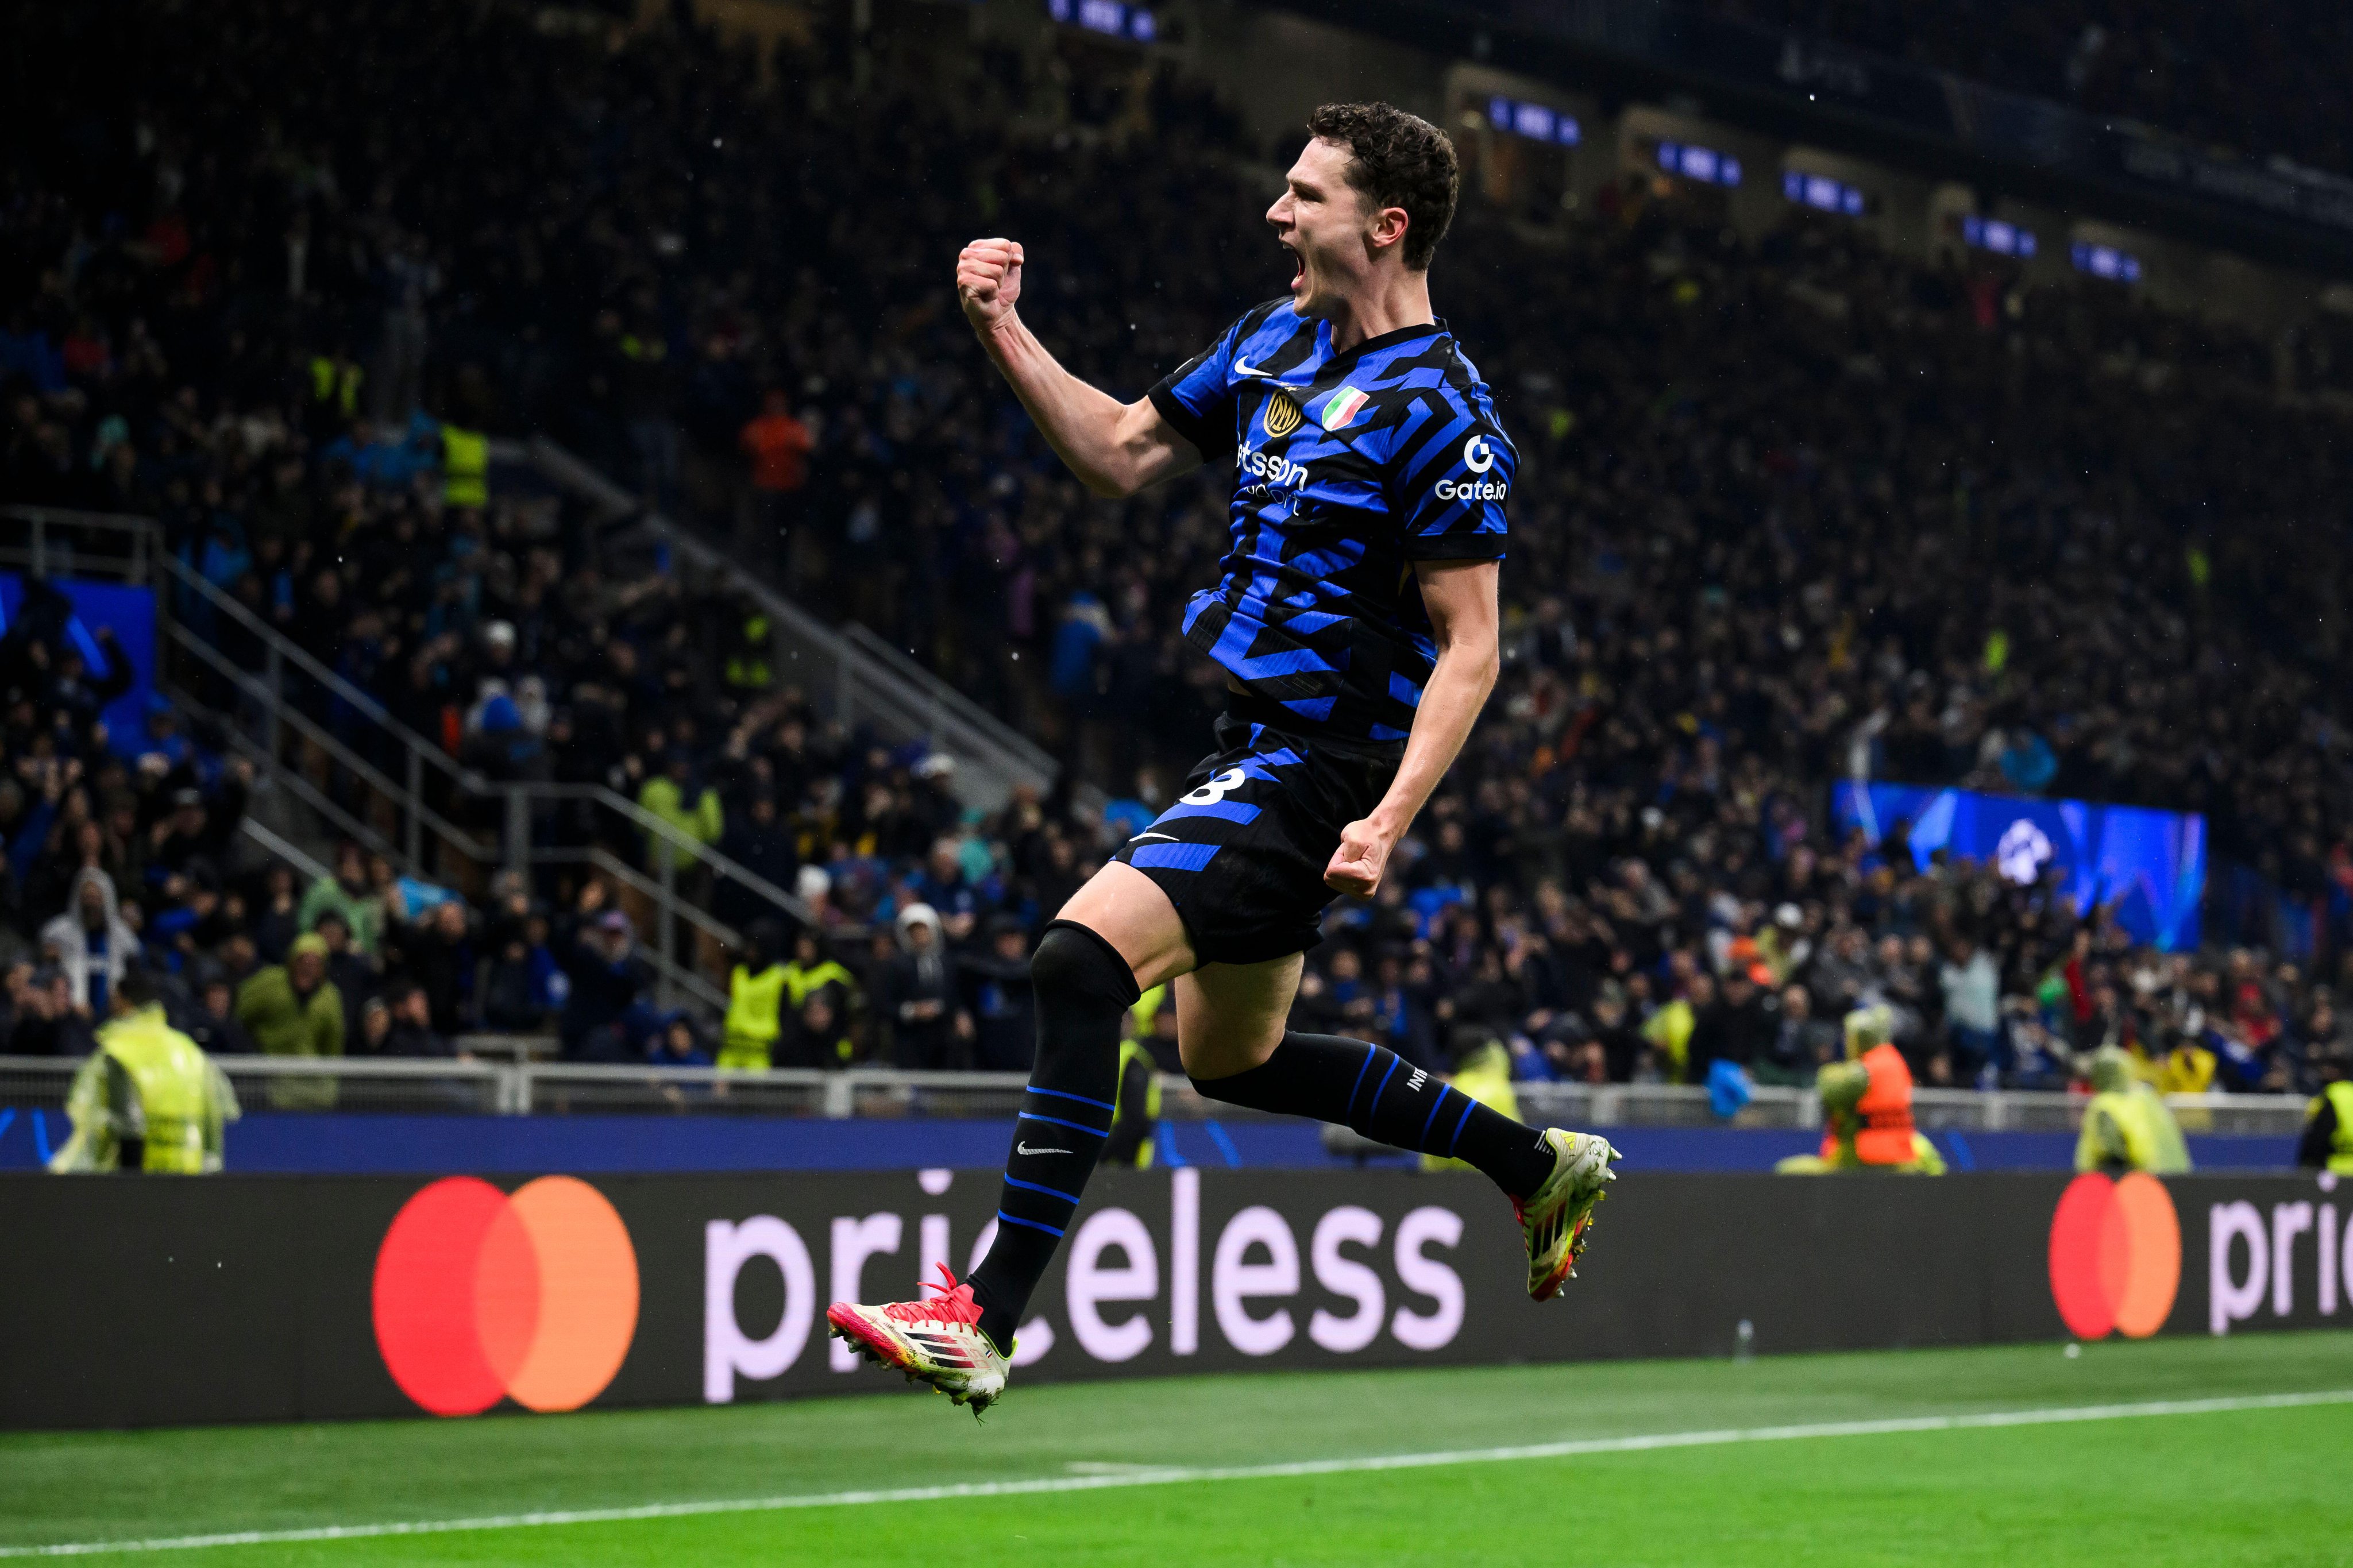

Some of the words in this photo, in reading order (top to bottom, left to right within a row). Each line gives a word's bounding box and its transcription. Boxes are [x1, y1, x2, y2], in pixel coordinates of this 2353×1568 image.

[1435, 479, 1506, 500] Gate.io
[1179, 768, 1245, 806] 8
[2209, 1169, 2353, 1337] pri
